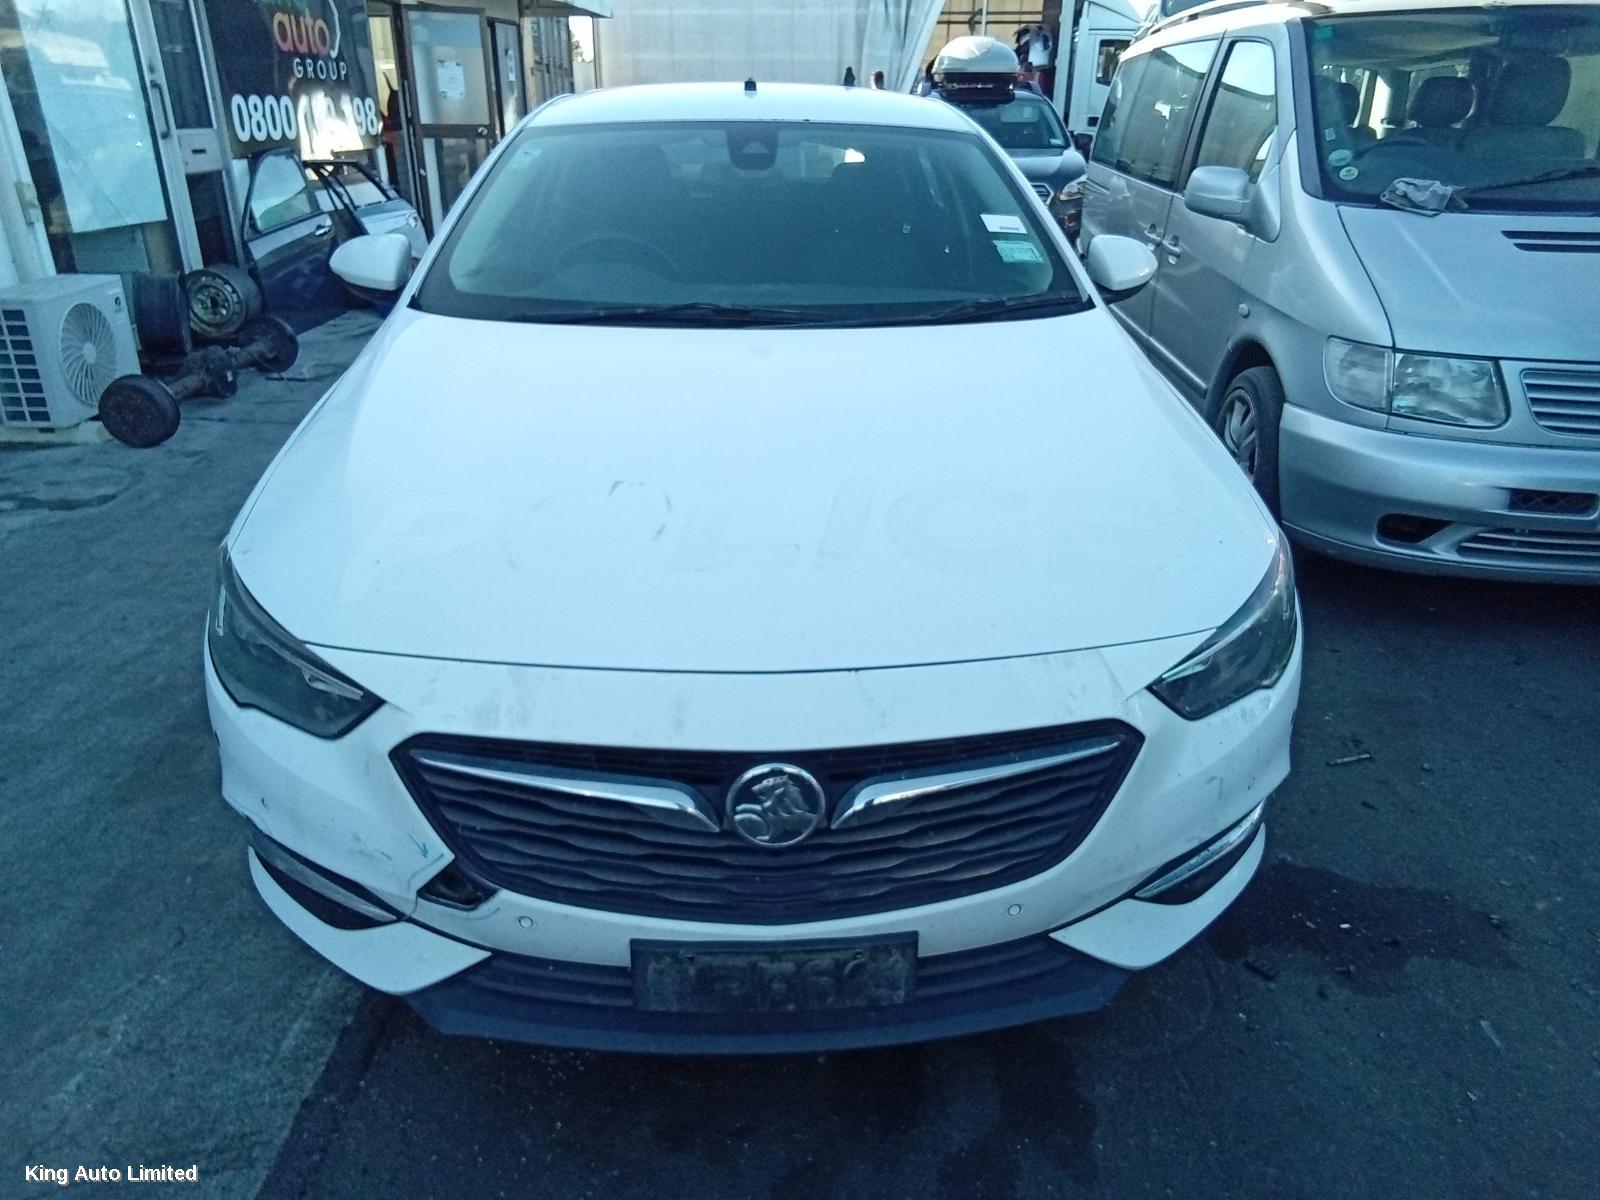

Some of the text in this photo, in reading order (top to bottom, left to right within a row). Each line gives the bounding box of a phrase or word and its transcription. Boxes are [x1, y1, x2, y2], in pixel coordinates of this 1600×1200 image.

[273, 11, 330, 55] auto
[293, 58, 348, 81] GROUP
[231, 93, 297, 142] 0800
